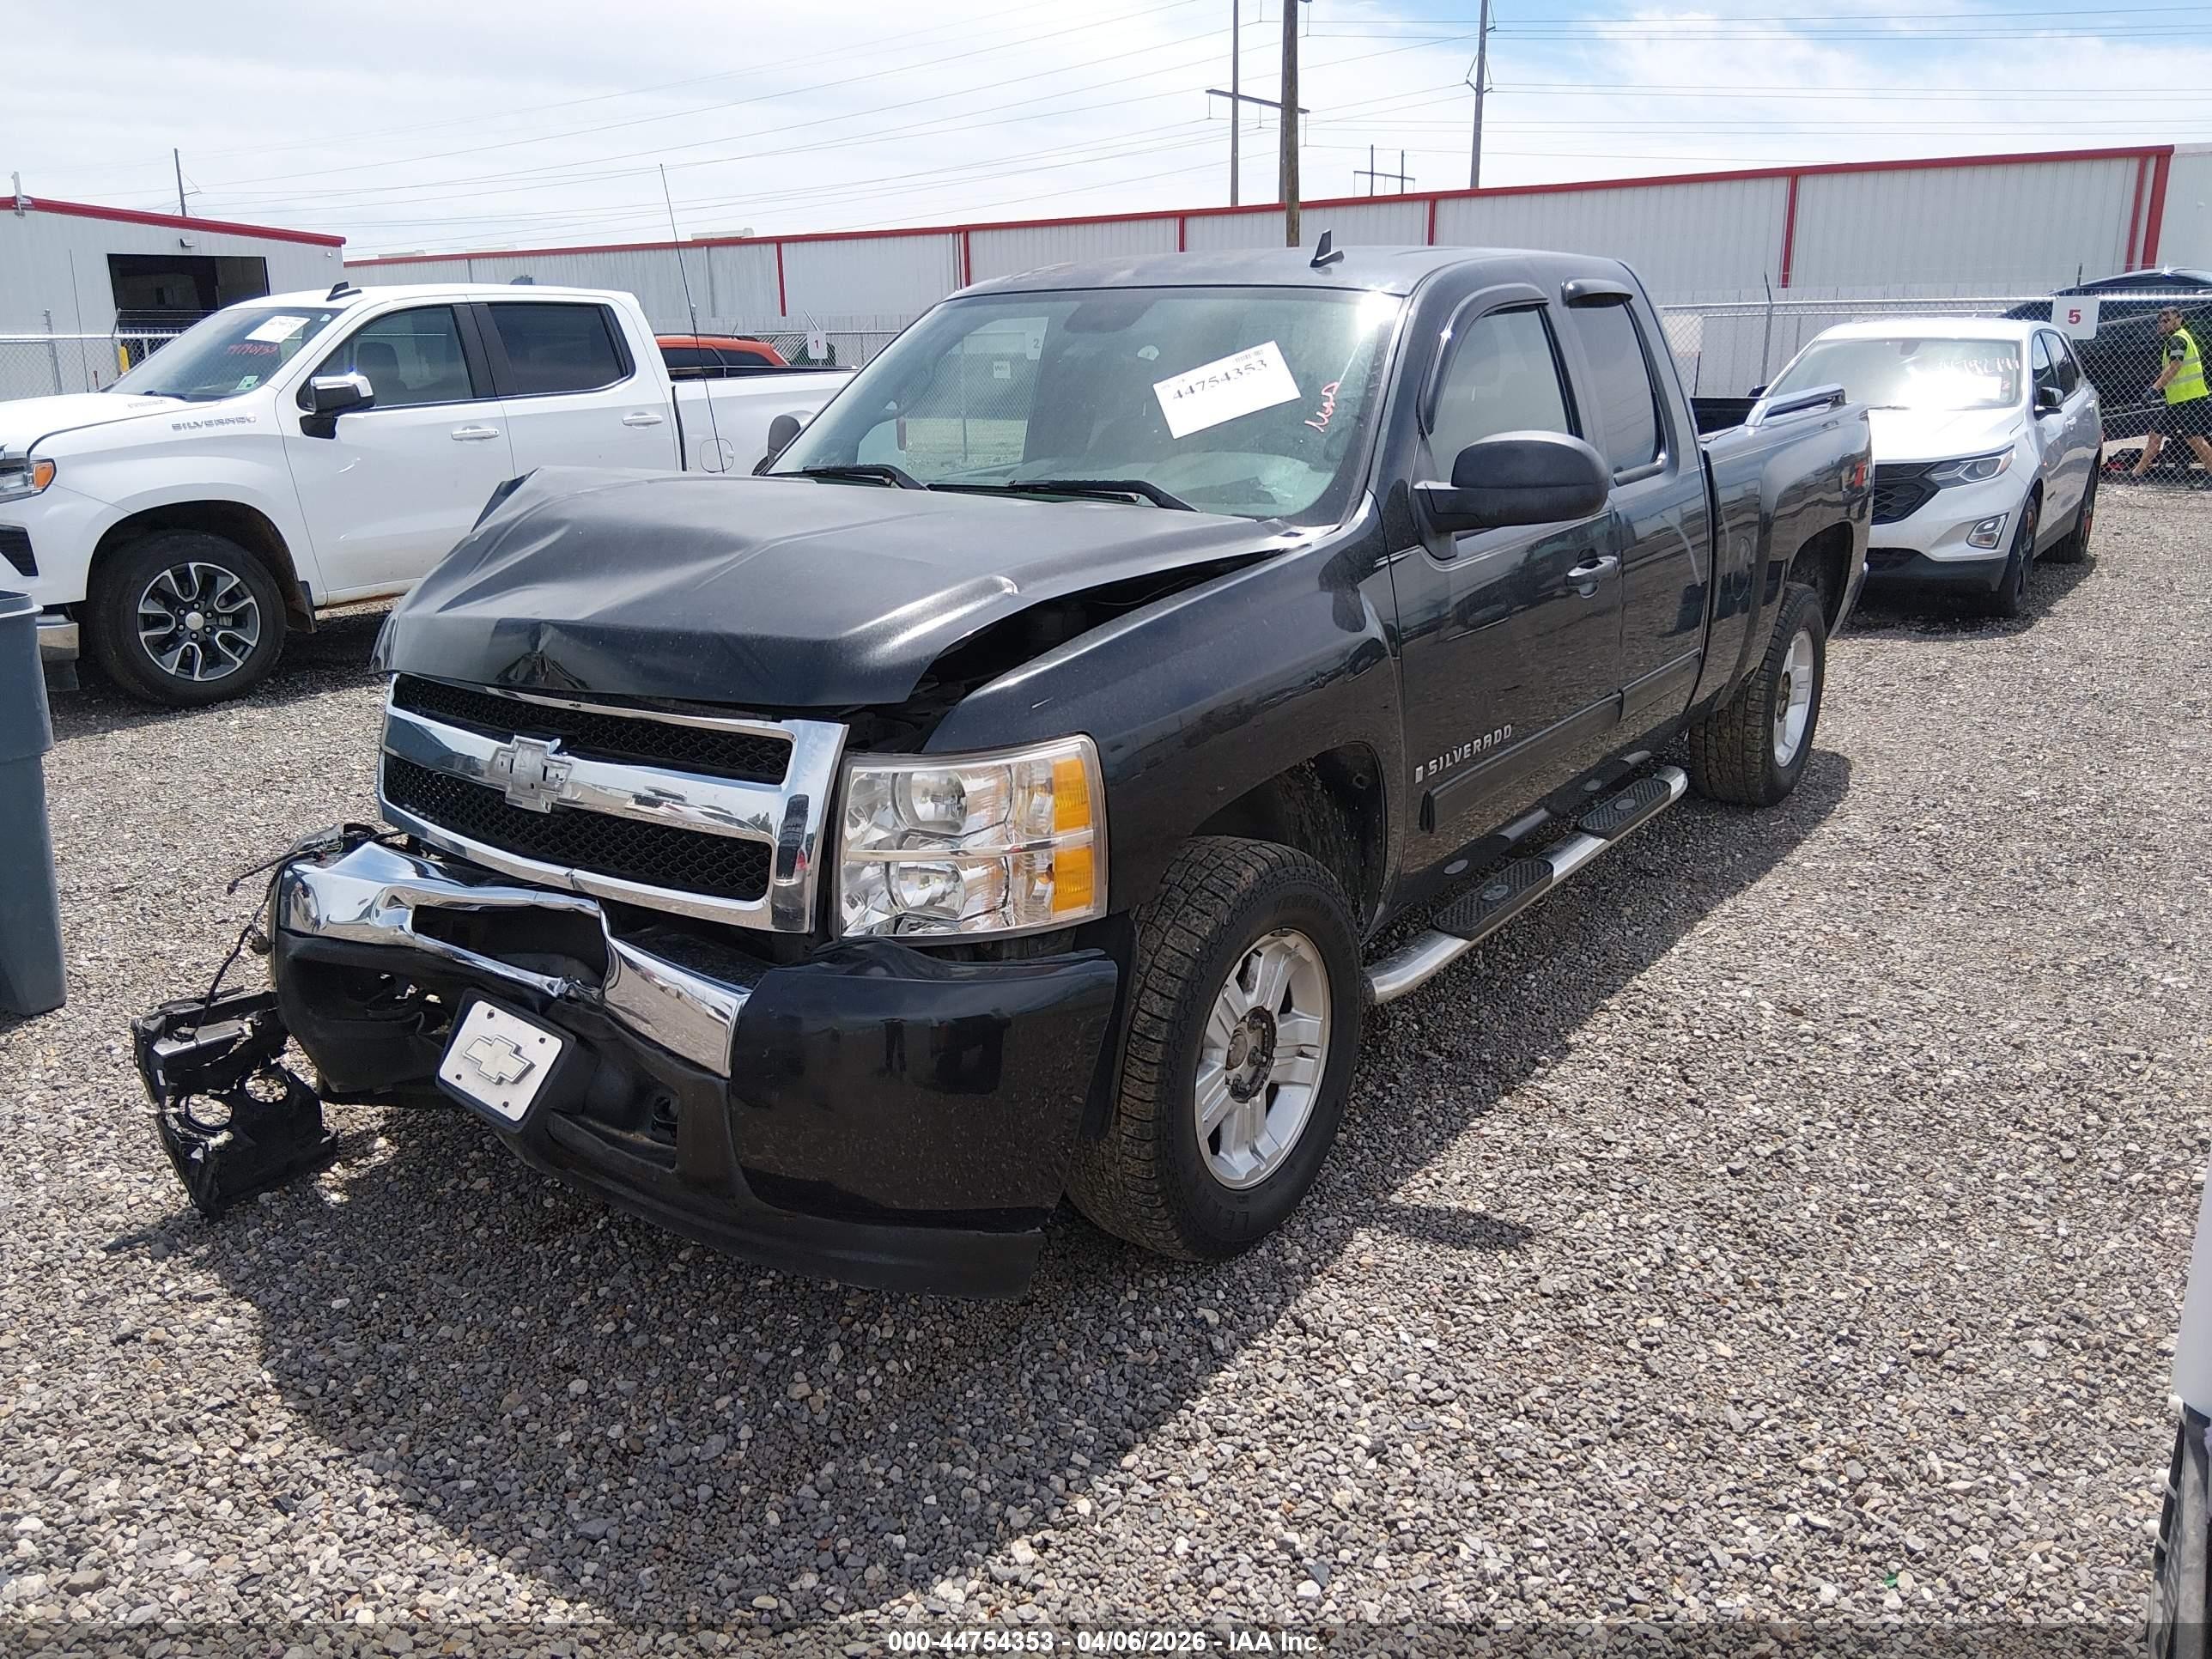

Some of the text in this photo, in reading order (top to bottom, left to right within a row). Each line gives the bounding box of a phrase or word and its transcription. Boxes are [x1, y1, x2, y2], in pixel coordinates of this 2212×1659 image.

[2068, 309, 2081, 325] 5
[814, 339, 819, 349] 1
[1033, 337, 1041, 349] 2
[1173, 359, 1267, 399] 44754353
[1427, 724, 1512, 776] SILVERADO
